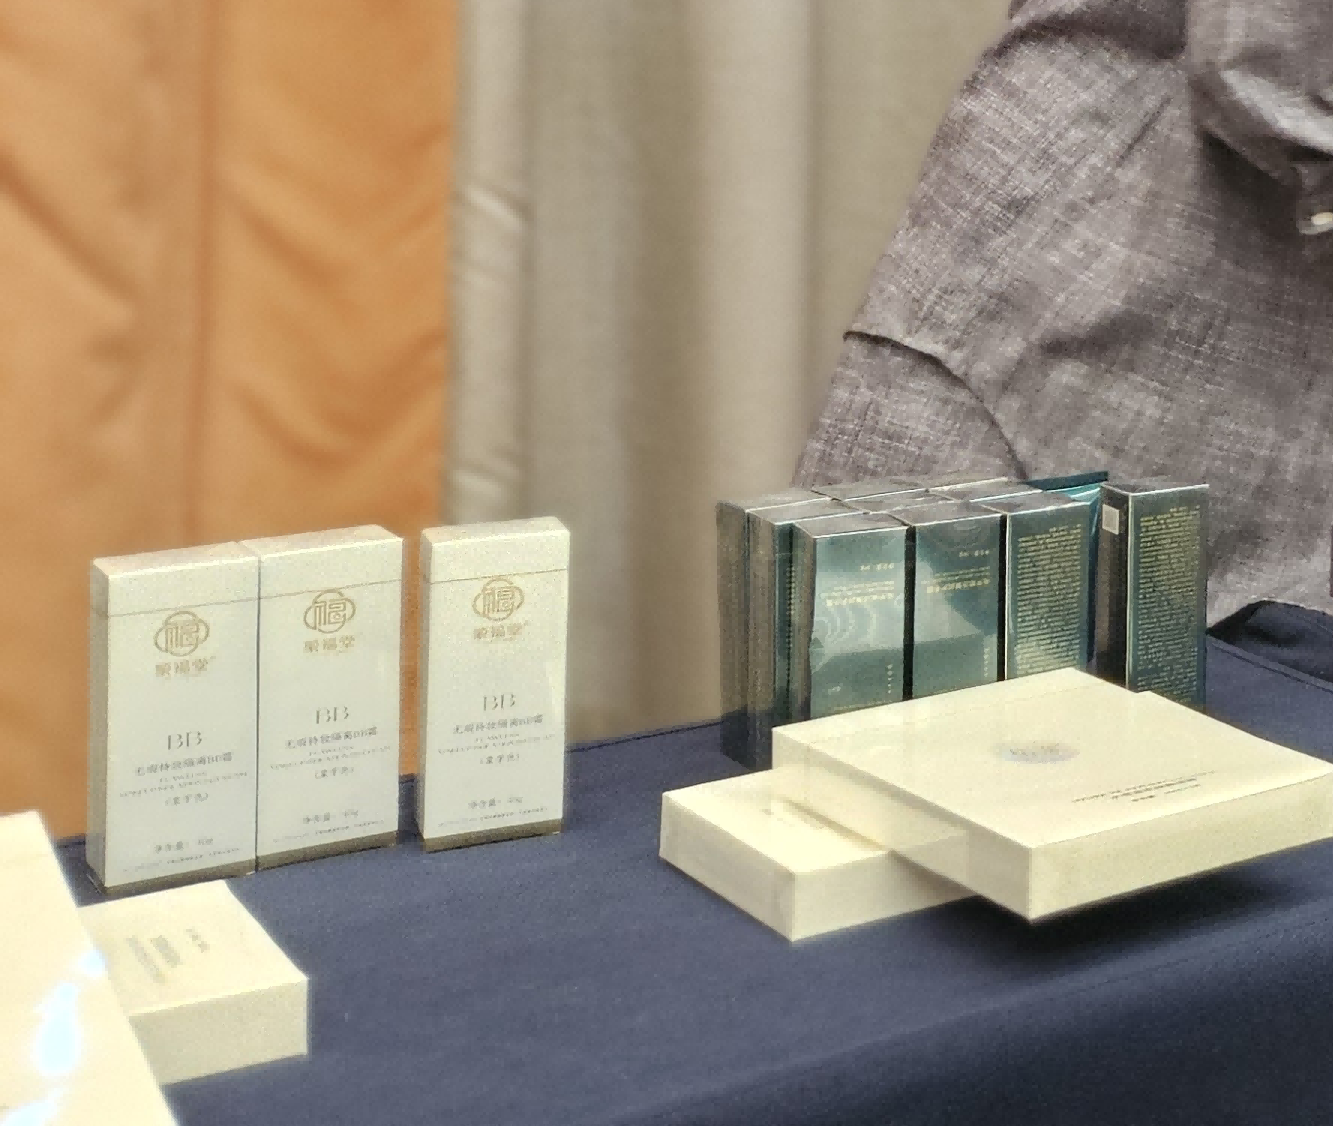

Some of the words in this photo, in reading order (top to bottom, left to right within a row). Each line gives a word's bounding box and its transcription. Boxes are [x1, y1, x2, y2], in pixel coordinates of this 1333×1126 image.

[483, 693, 516, 711] BB
[315, 706, 349, 724] BB
[167, 731, 202, 750] BB
